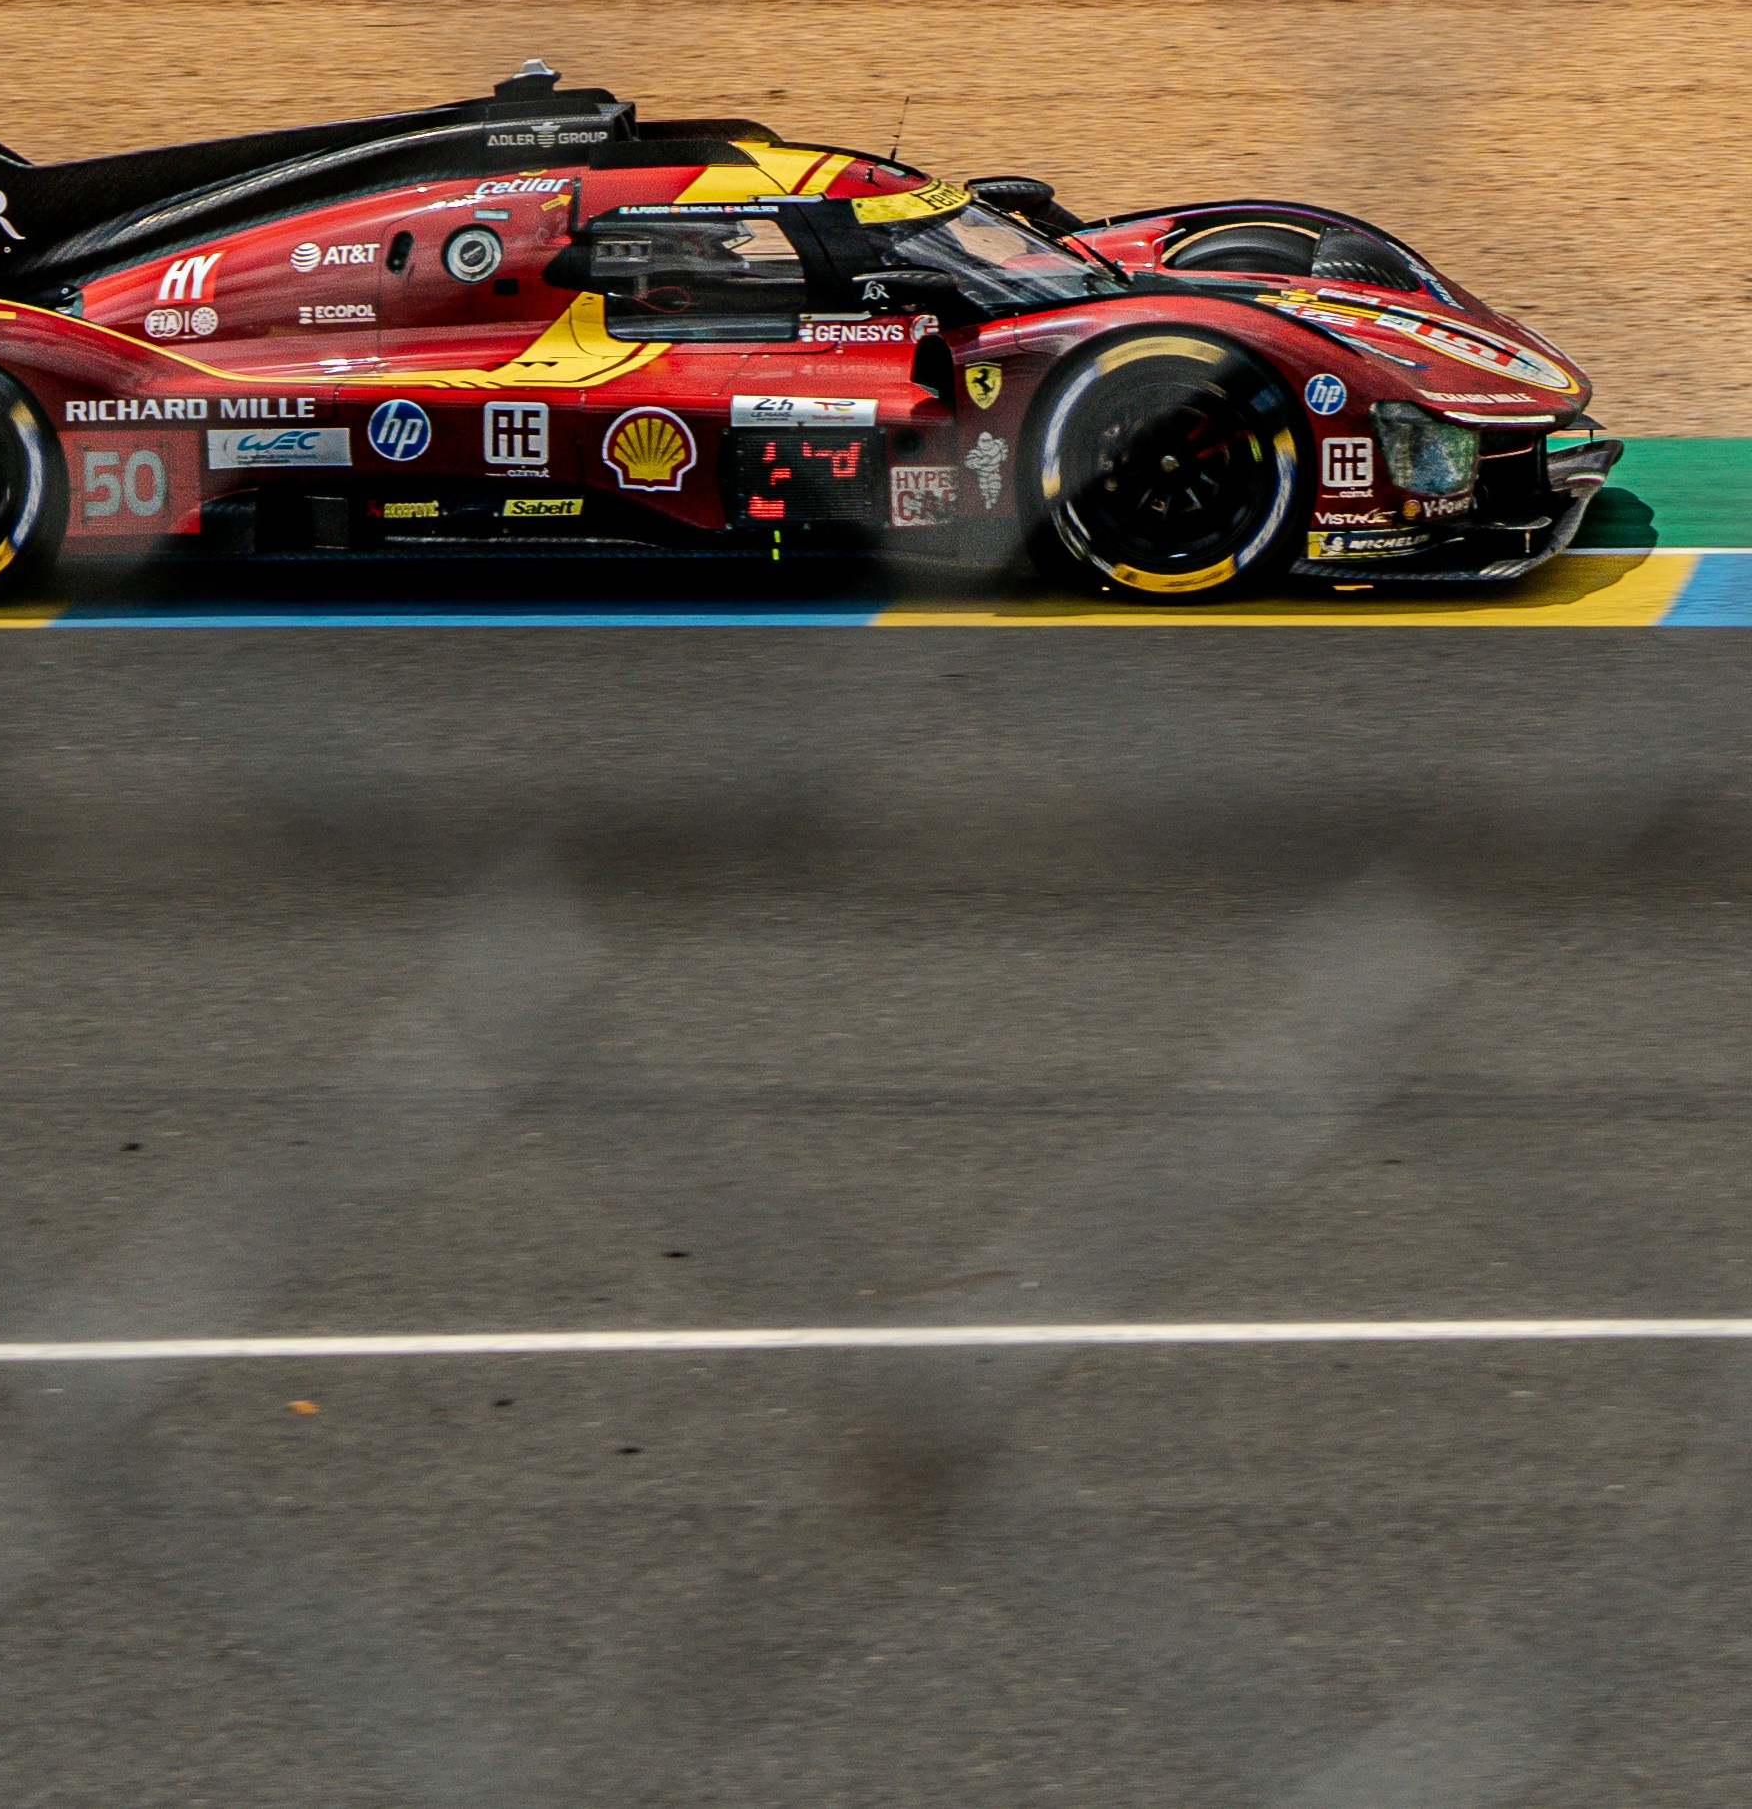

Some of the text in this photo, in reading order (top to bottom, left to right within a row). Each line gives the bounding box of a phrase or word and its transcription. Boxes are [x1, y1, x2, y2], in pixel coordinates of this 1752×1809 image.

[487, 131, 608, 147] ADLER GROUP
[322, 243, 381, 266] AT&T
[315, 304, 377, 319] ECOPOL
[815, 324, 904, 342] GENESYS
[1310, 376, 1341, 412] hp
[65, 397, 316, 422] RICHARD MILLE
[237, 430, 321, 450] WEC
[377, 401, 423, 458] hp
[83, 449, 167, 517] 50
[512, 501, 574, 515] Sabelt
